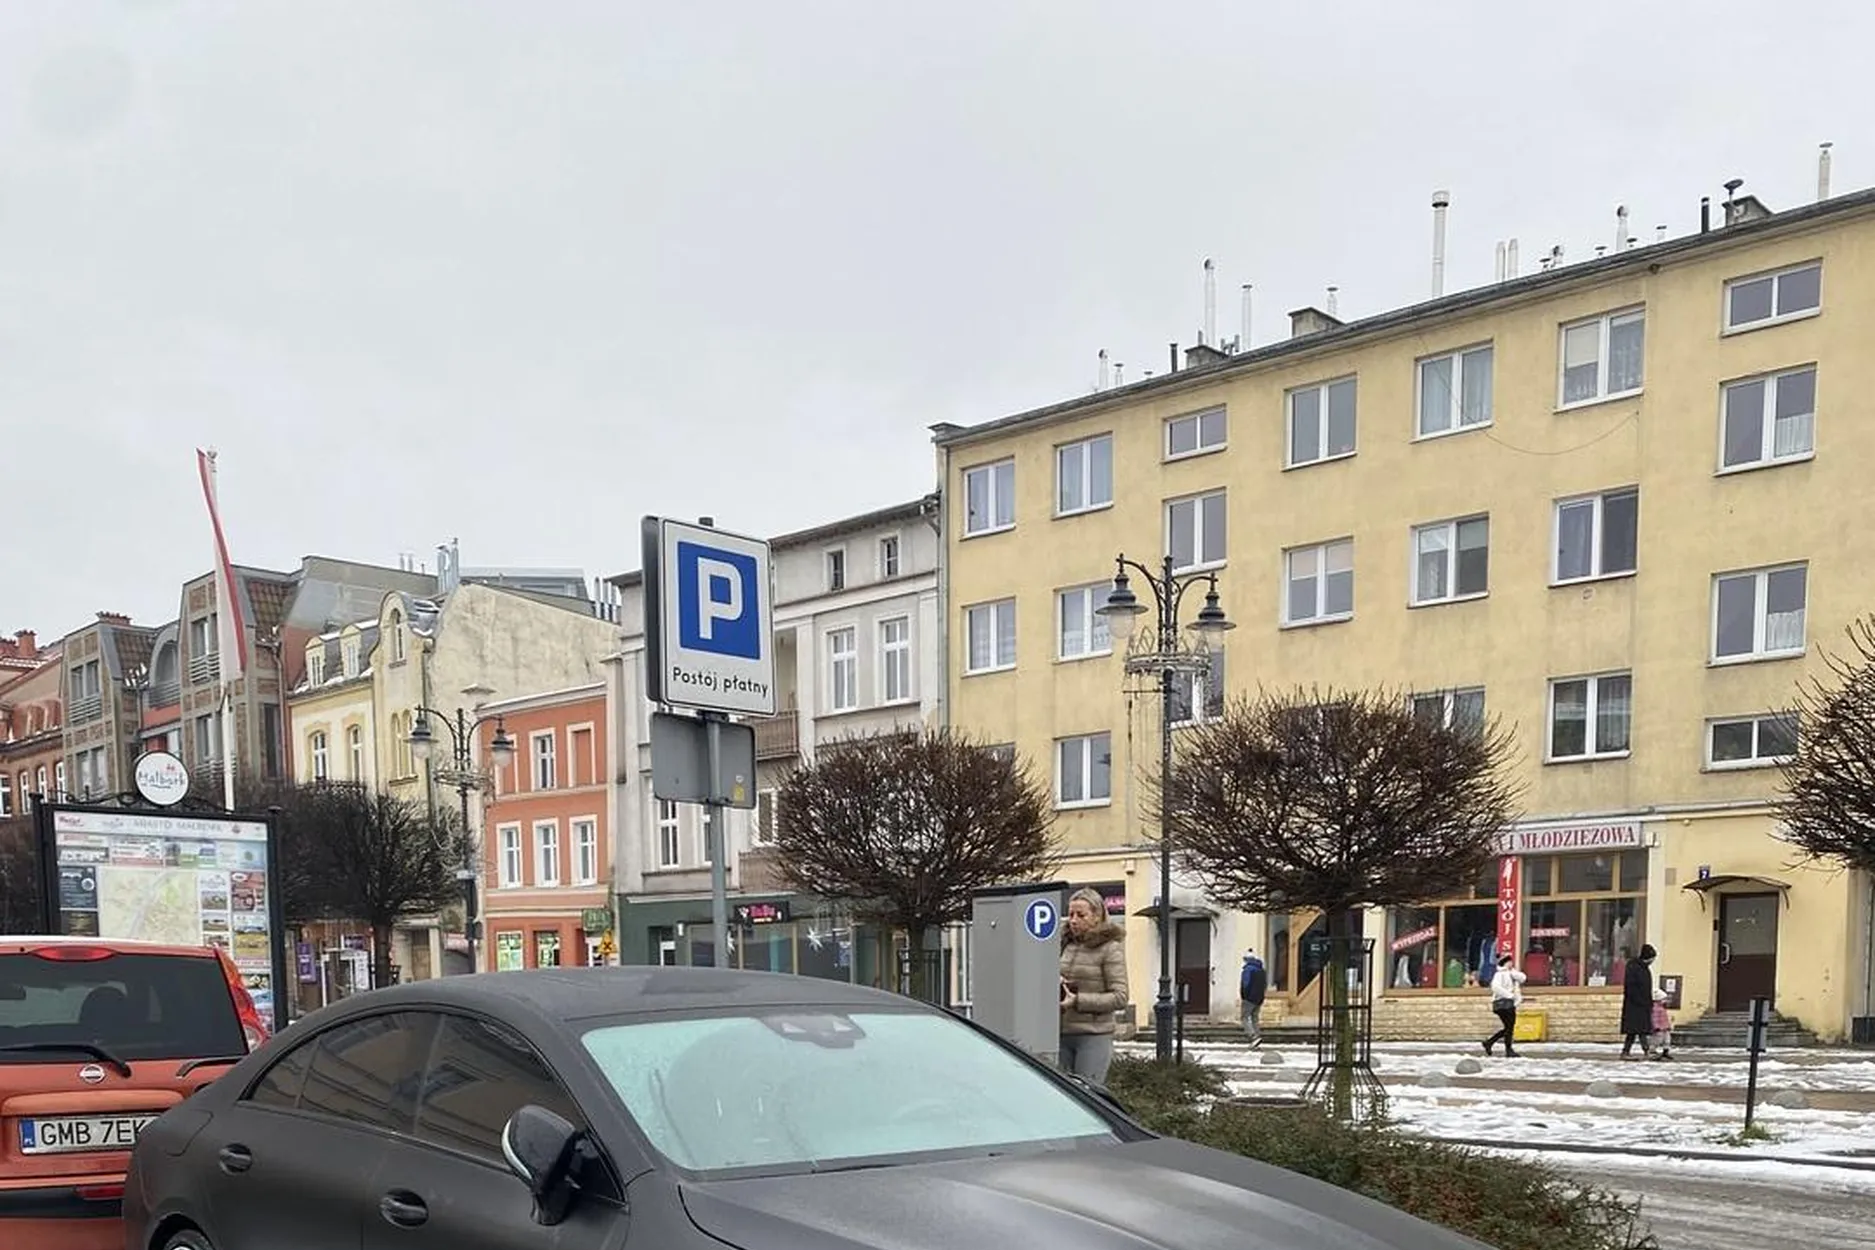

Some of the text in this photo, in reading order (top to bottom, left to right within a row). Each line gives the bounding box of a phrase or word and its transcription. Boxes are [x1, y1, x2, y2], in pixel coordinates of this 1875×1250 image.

[698, 557, 743, 640] P
[673, 666, 769, 699] Postój płatny
[1034, 906, 1051, 934] P
[40, 1121, 91, 1146] GMB
